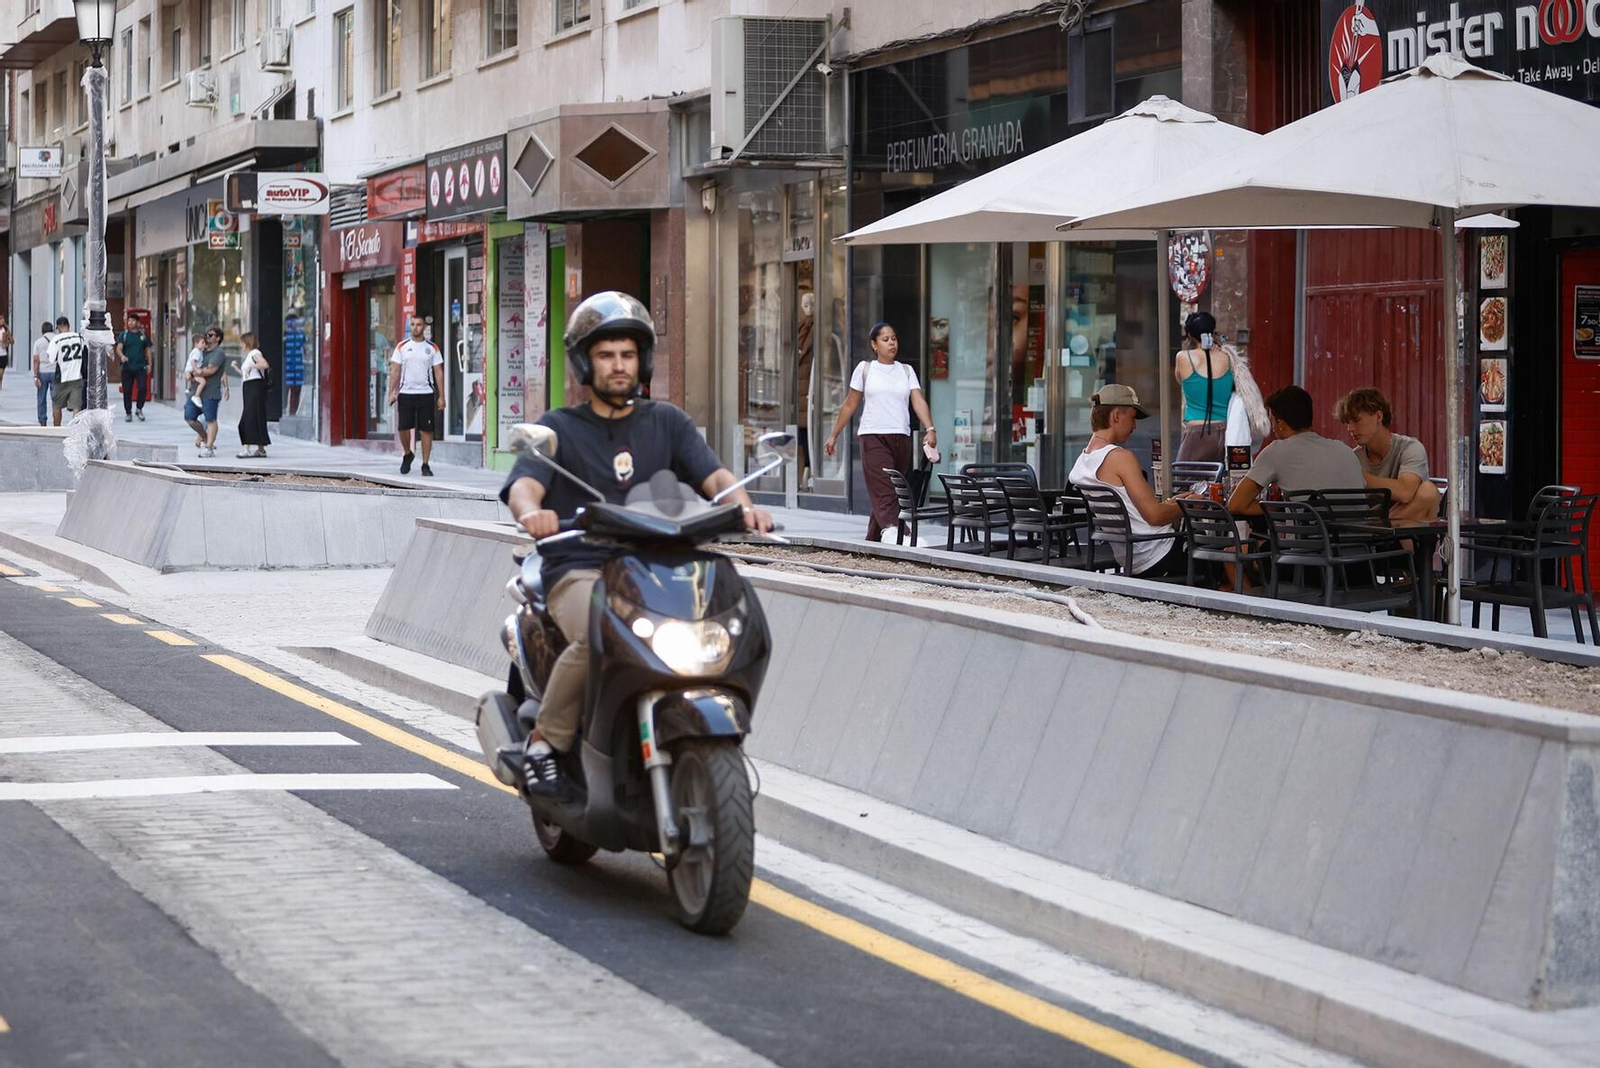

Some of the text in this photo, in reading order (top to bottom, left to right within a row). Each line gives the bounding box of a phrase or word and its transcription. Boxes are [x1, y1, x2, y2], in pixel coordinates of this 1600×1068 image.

[1387, 1, 1504, 72] mister
[1518, 68, 1541, 84] Take
[1544, 64, 1573, 81] Away
[887, 119, 1024, 174] PERFUMERIA GRANADA
[266, 188, 309, 197] autoVIP
[61, 343, 82, 362] 22
